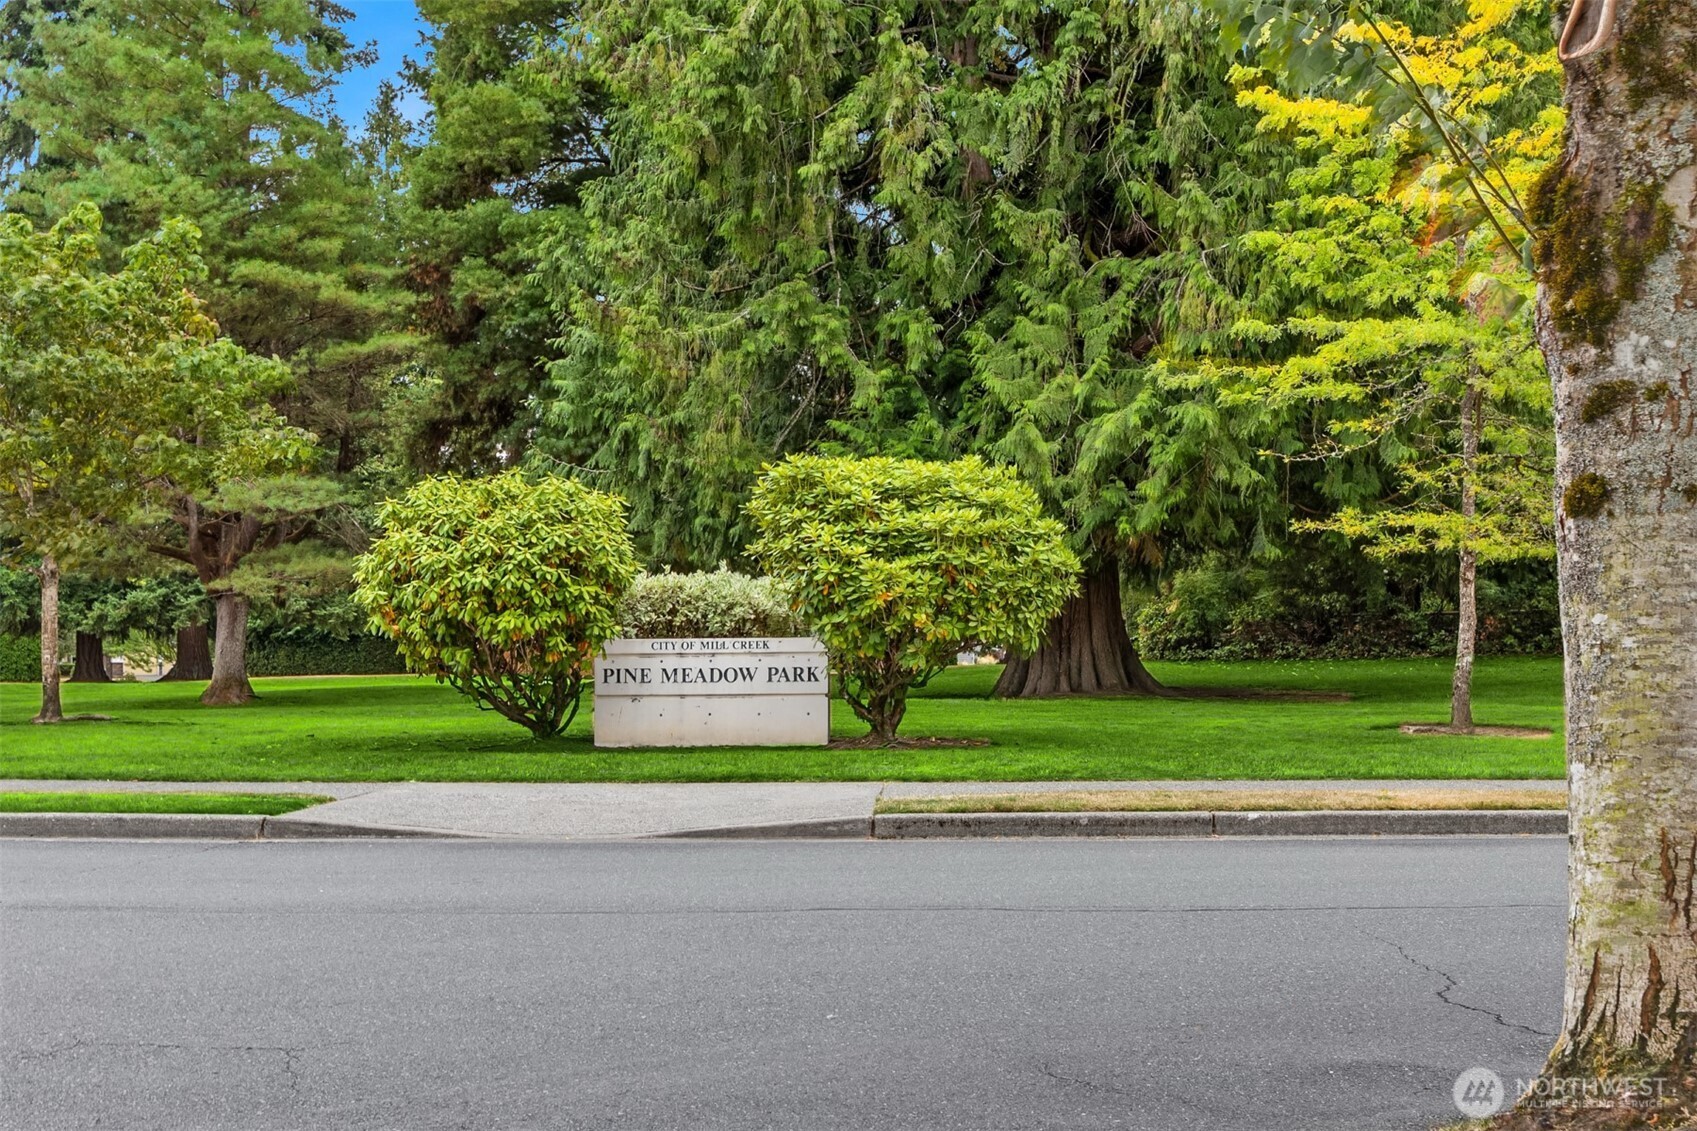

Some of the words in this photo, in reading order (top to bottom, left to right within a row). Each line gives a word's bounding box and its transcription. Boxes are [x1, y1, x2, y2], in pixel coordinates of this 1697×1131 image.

[651, 641, 677, 651] CITY
[681, 641, 696, 650] OF
[701, 641, 729, 650] MILL
[732, 640, 770, 650] CREEK
[602, 668, 652, 684] PINE
[661, 667, 758, 684] MEADOW
[766, 666, 820, 683] PARK
